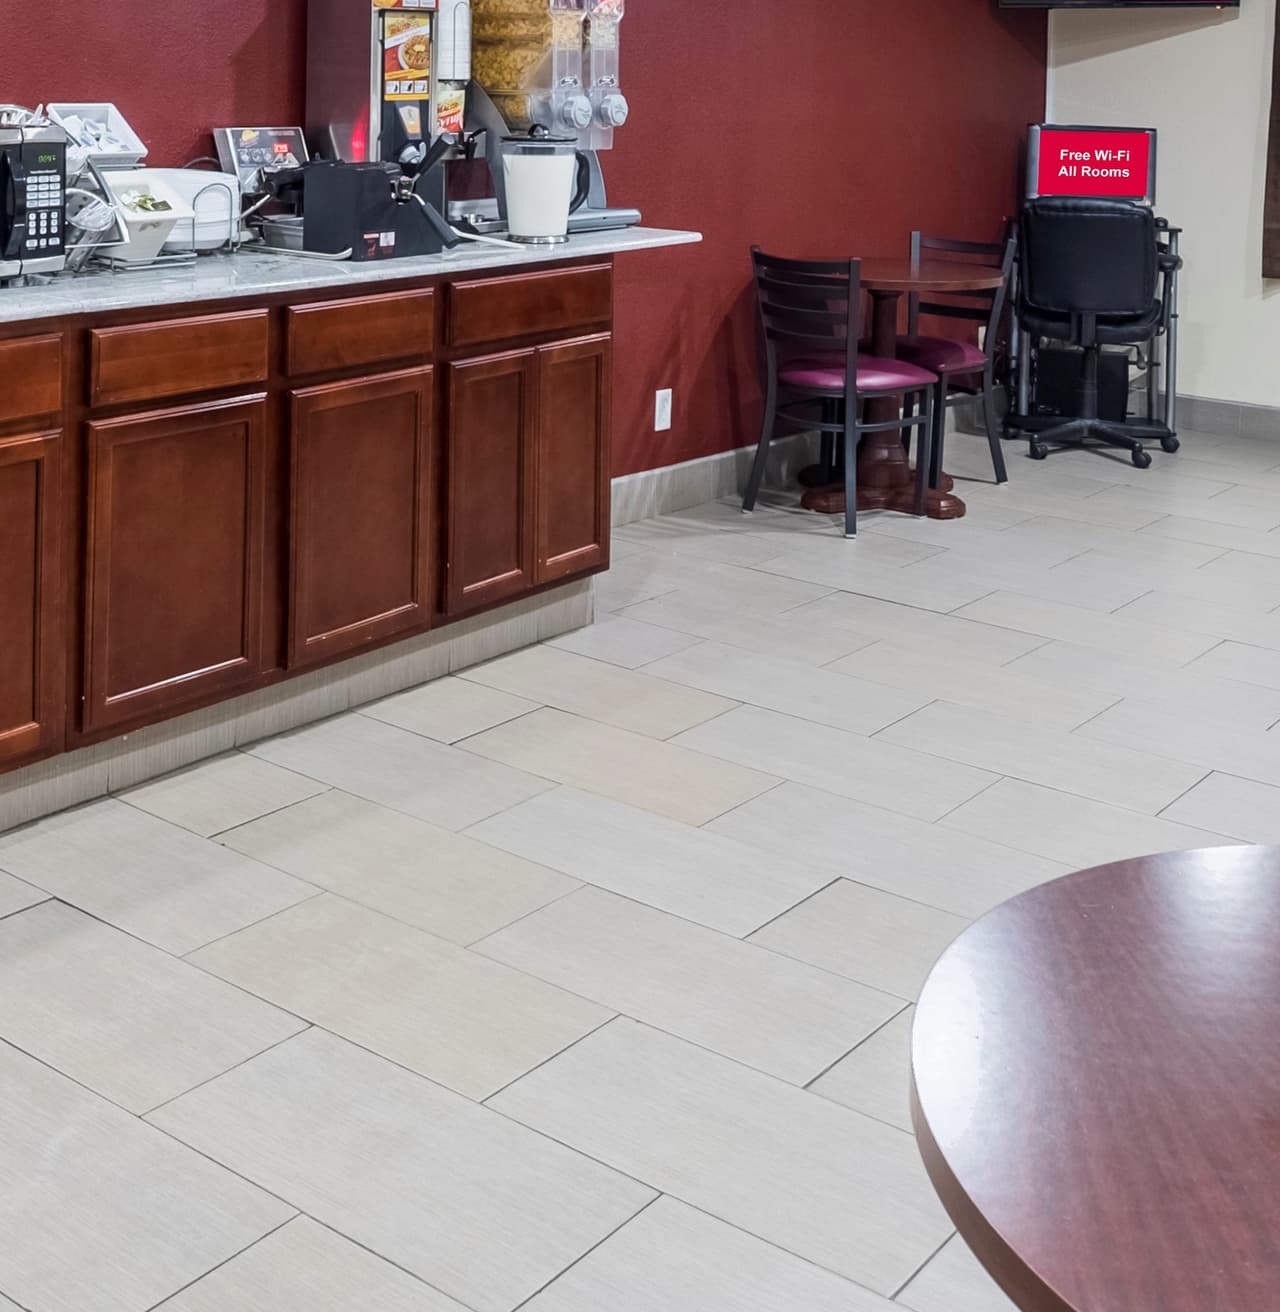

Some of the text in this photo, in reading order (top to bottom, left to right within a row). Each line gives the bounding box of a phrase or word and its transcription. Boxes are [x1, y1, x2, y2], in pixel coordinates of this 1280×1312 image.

[1060, 149, 1130, 161] Free Wi-Fi
[1058, 165, 1130, 178] All Rooms
